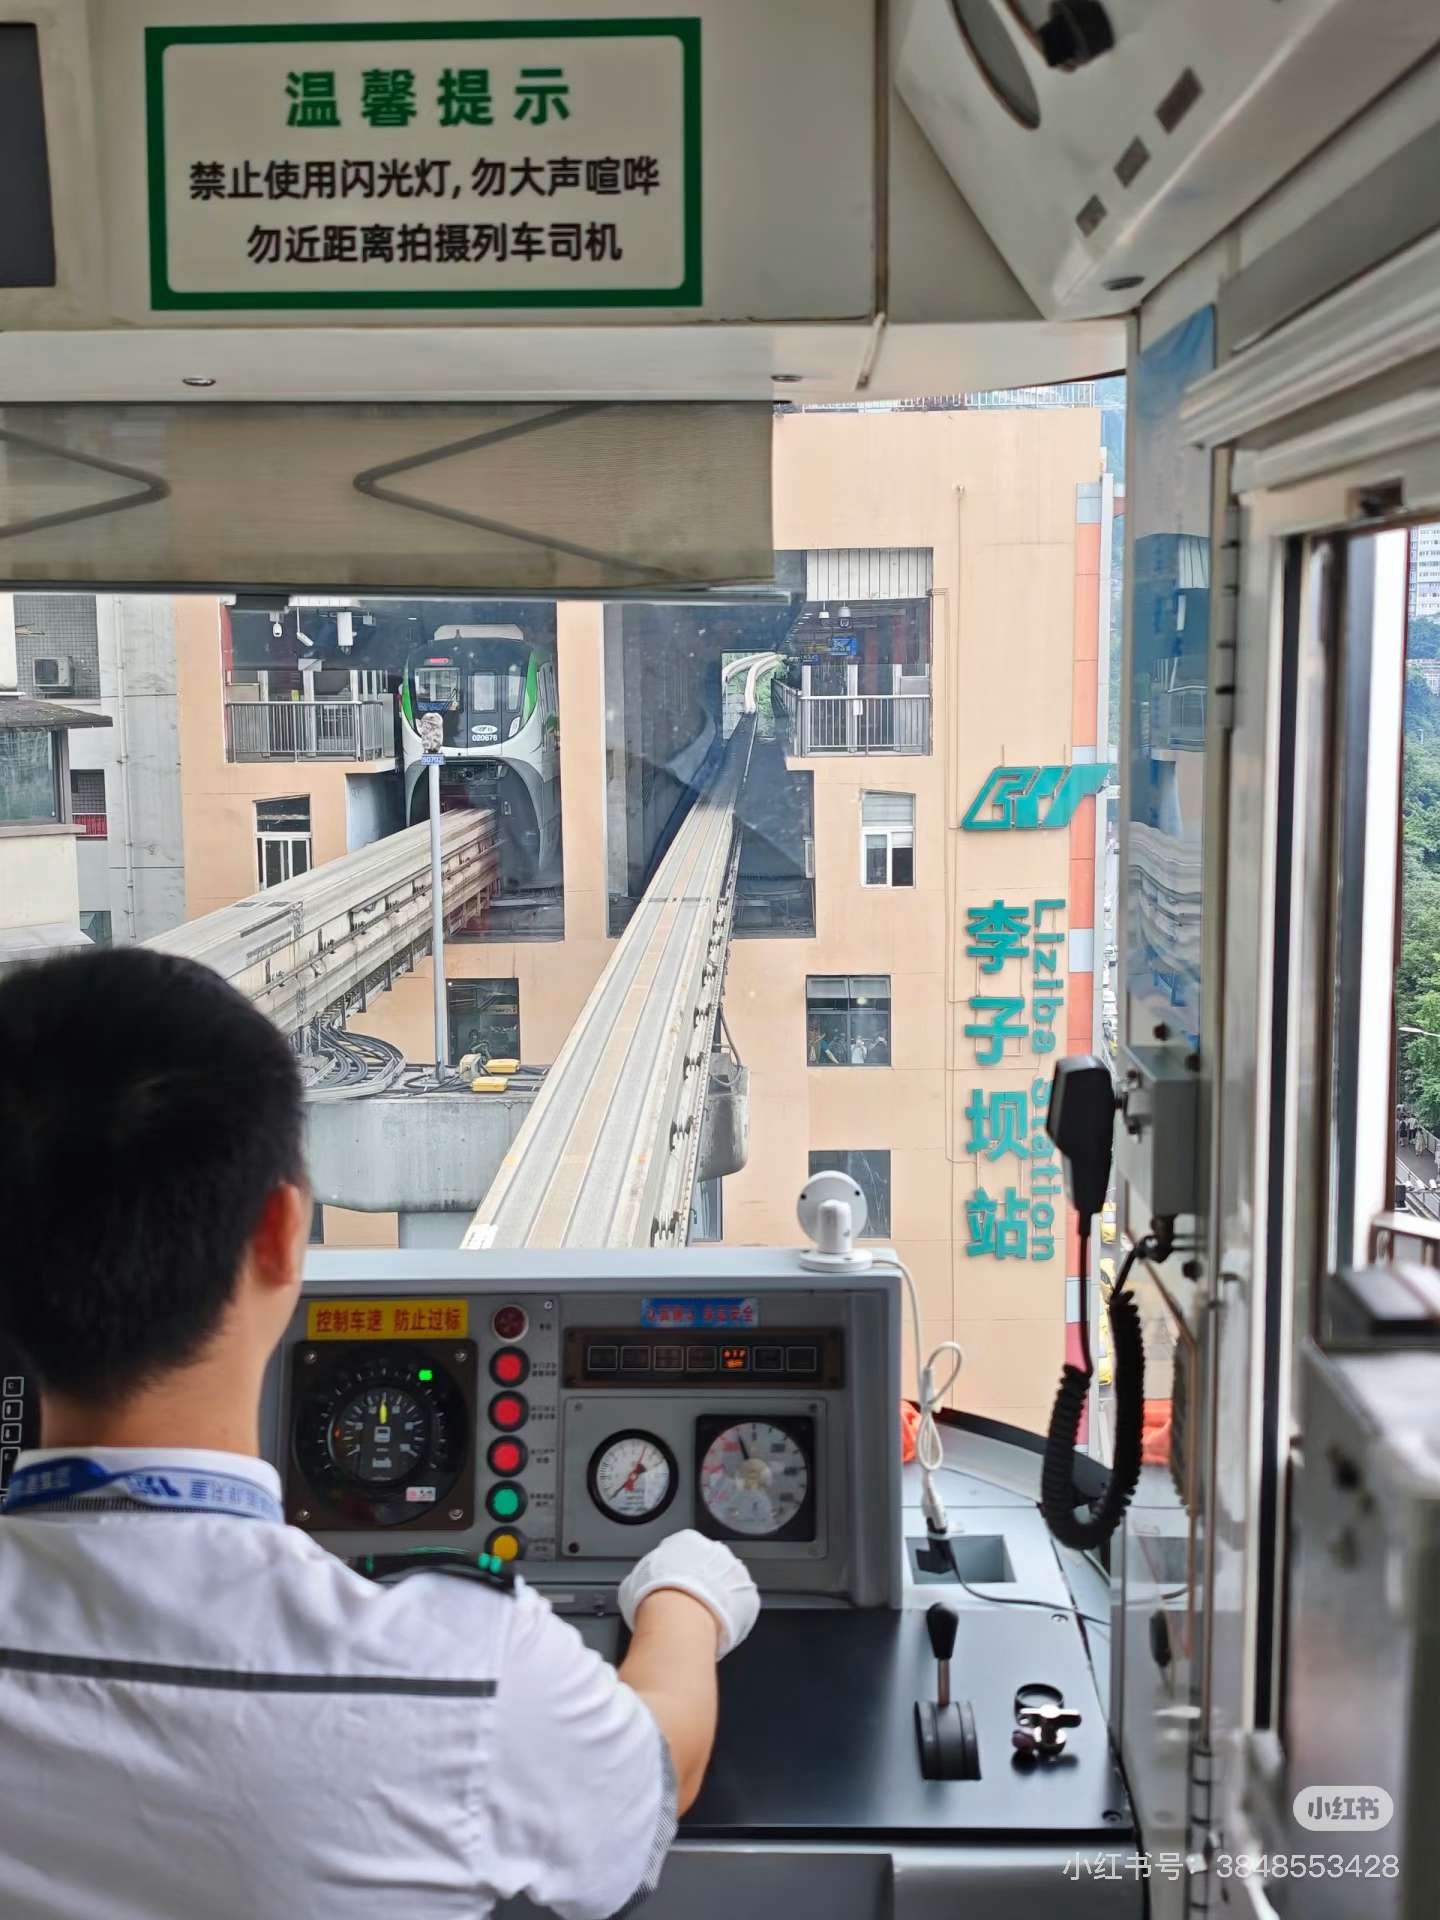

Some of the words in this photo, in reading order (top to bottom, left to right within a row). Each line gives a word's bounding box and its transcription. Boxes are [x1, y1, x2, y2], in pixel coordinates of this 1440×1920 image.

[285, 68, 570, 127] 温馨提示
[247, 221, 623, 263] 勿近距离拍摄列车司机
[1031, 898, 1066, 1053] Liziba
[964, 898, 1030, 1261] 李子坝站
[316, 1308, 383, 1333] 控制车速
[394, 1307, 461, 1331] 防止过标
